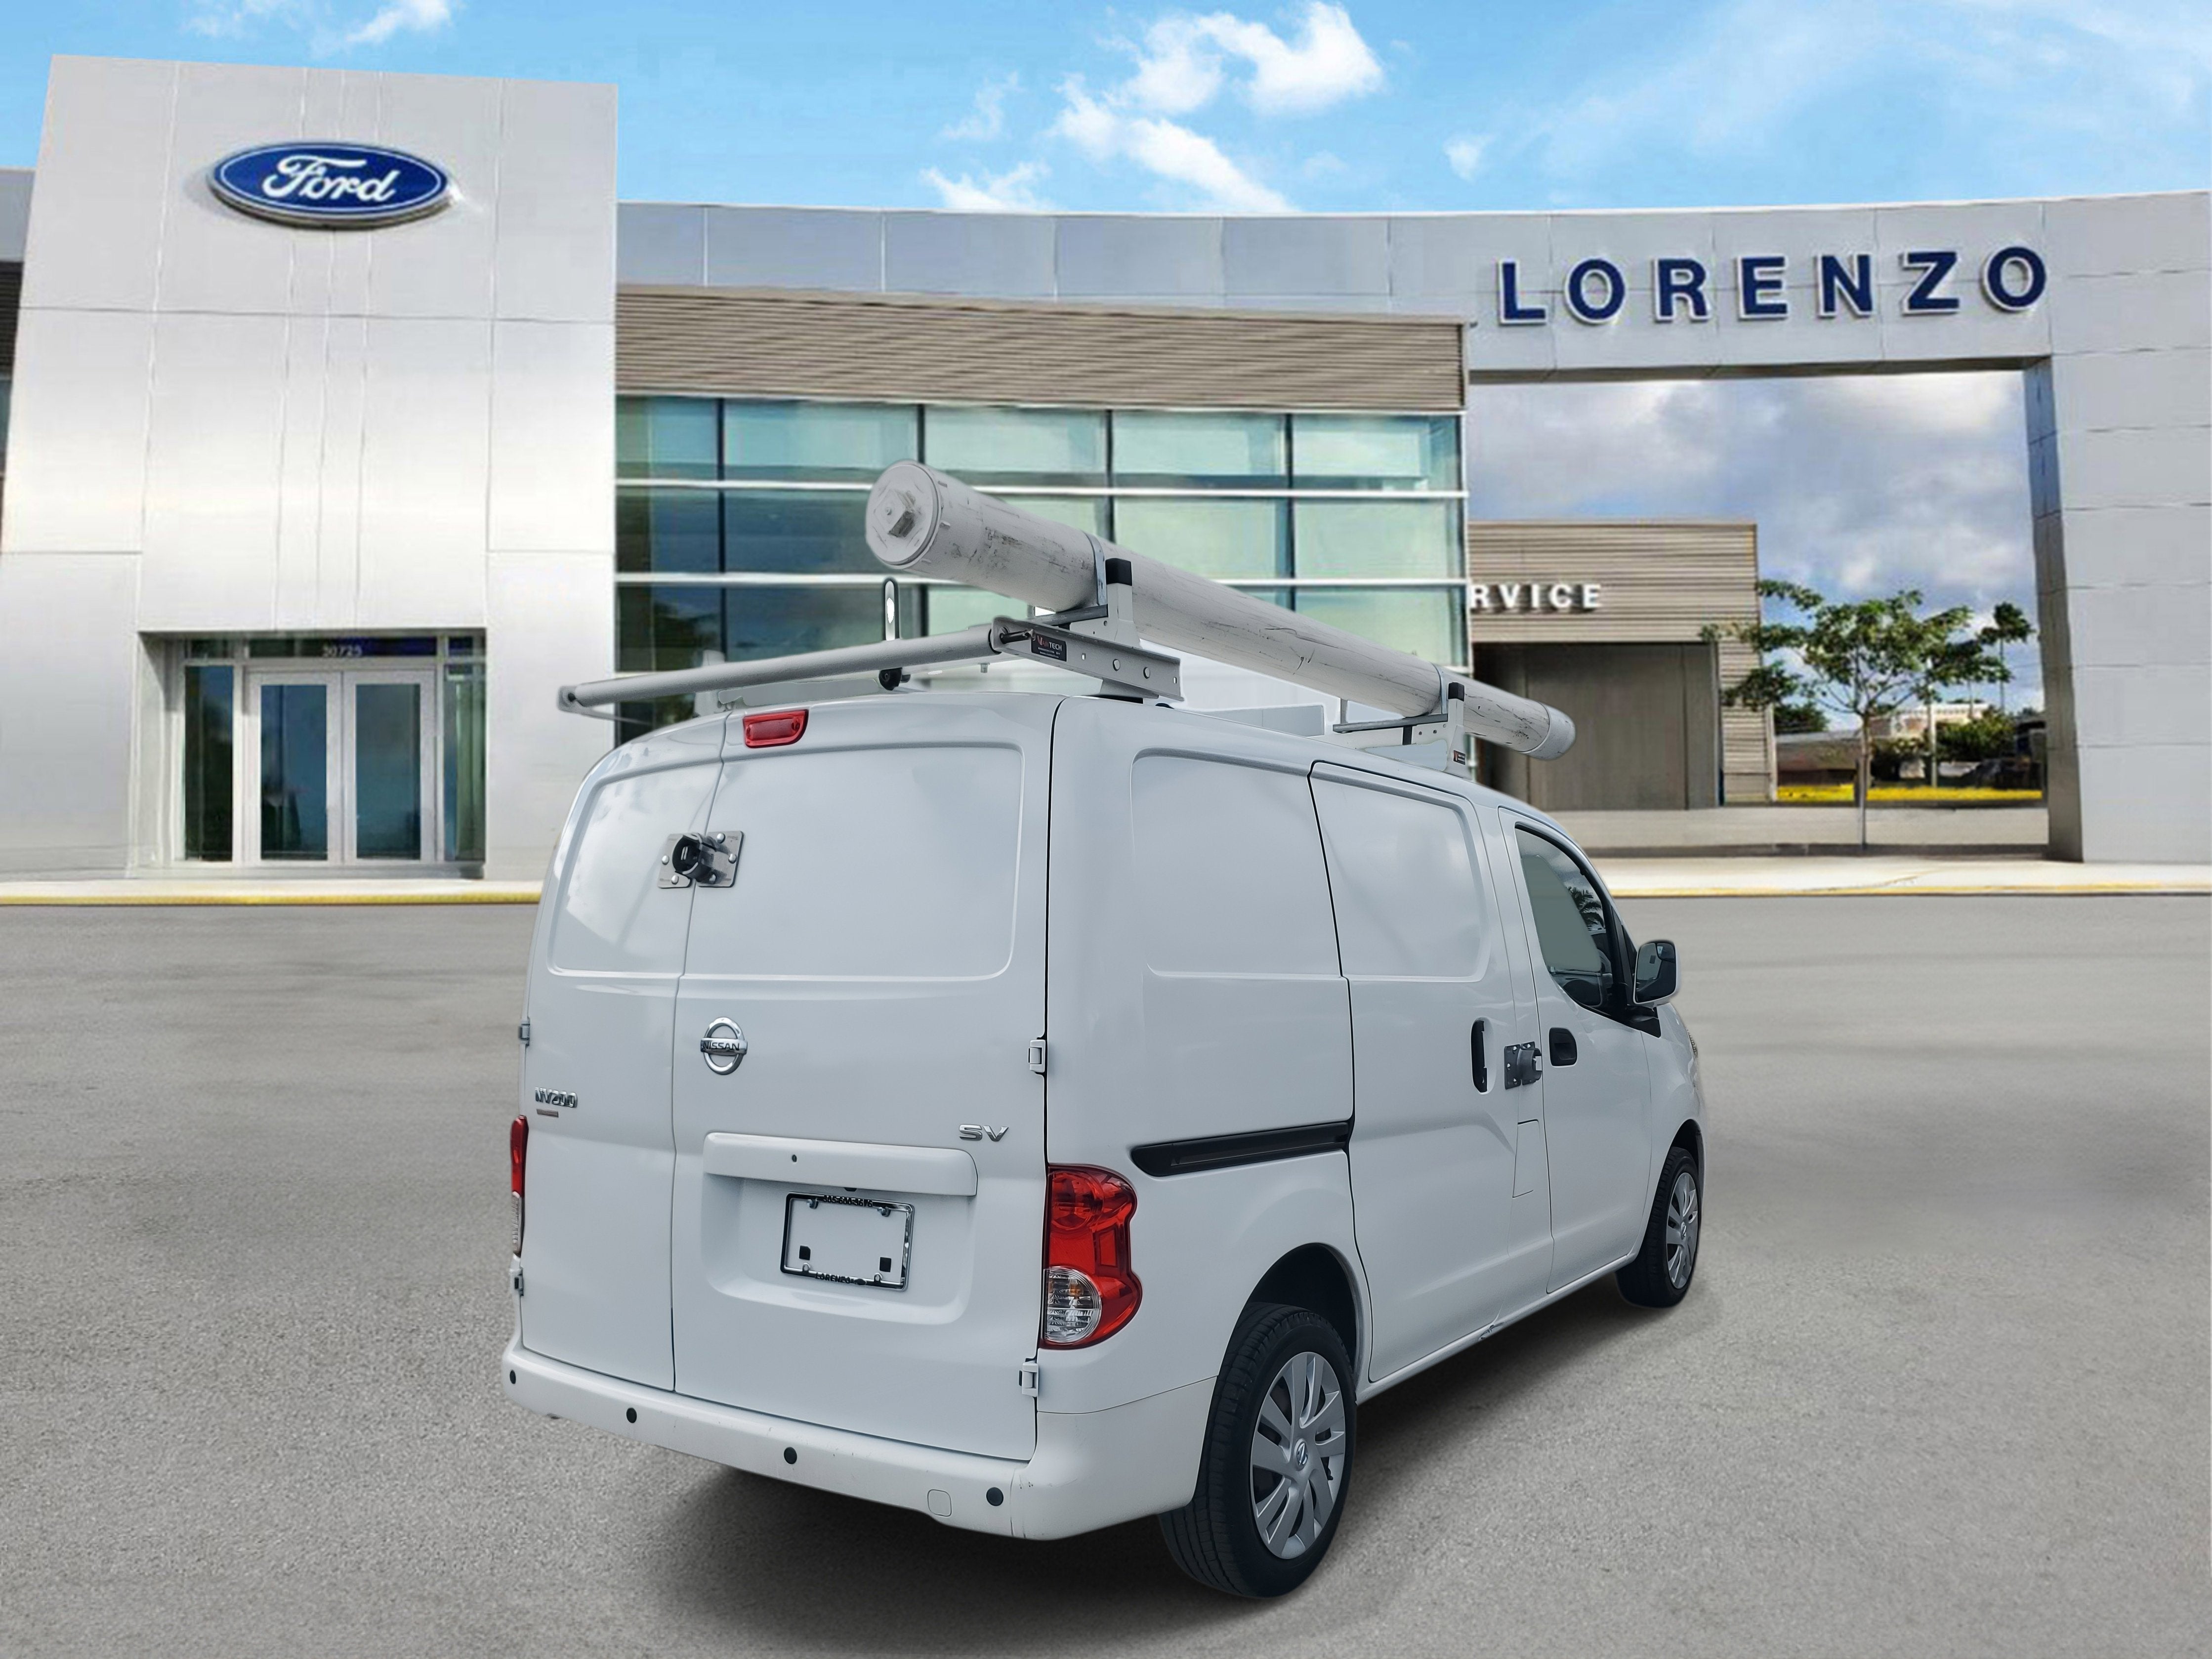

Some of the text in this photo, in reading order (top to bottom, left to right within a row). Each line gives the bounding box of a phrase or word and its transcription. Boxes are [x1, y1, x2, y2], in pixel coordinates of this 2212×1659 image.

[262, 155, 399, 202] Ford
[1499, 246, 2048, 324] LORENZO
[1469, 583, 1601, 609] RVICE
[703, 1041, 740, 1051] NISSAN
[535, 1087, 578, 1108] NV200
[959, 1123, 1009, 1142] SV
[815, 1272, 851, 1284] LORENZO
